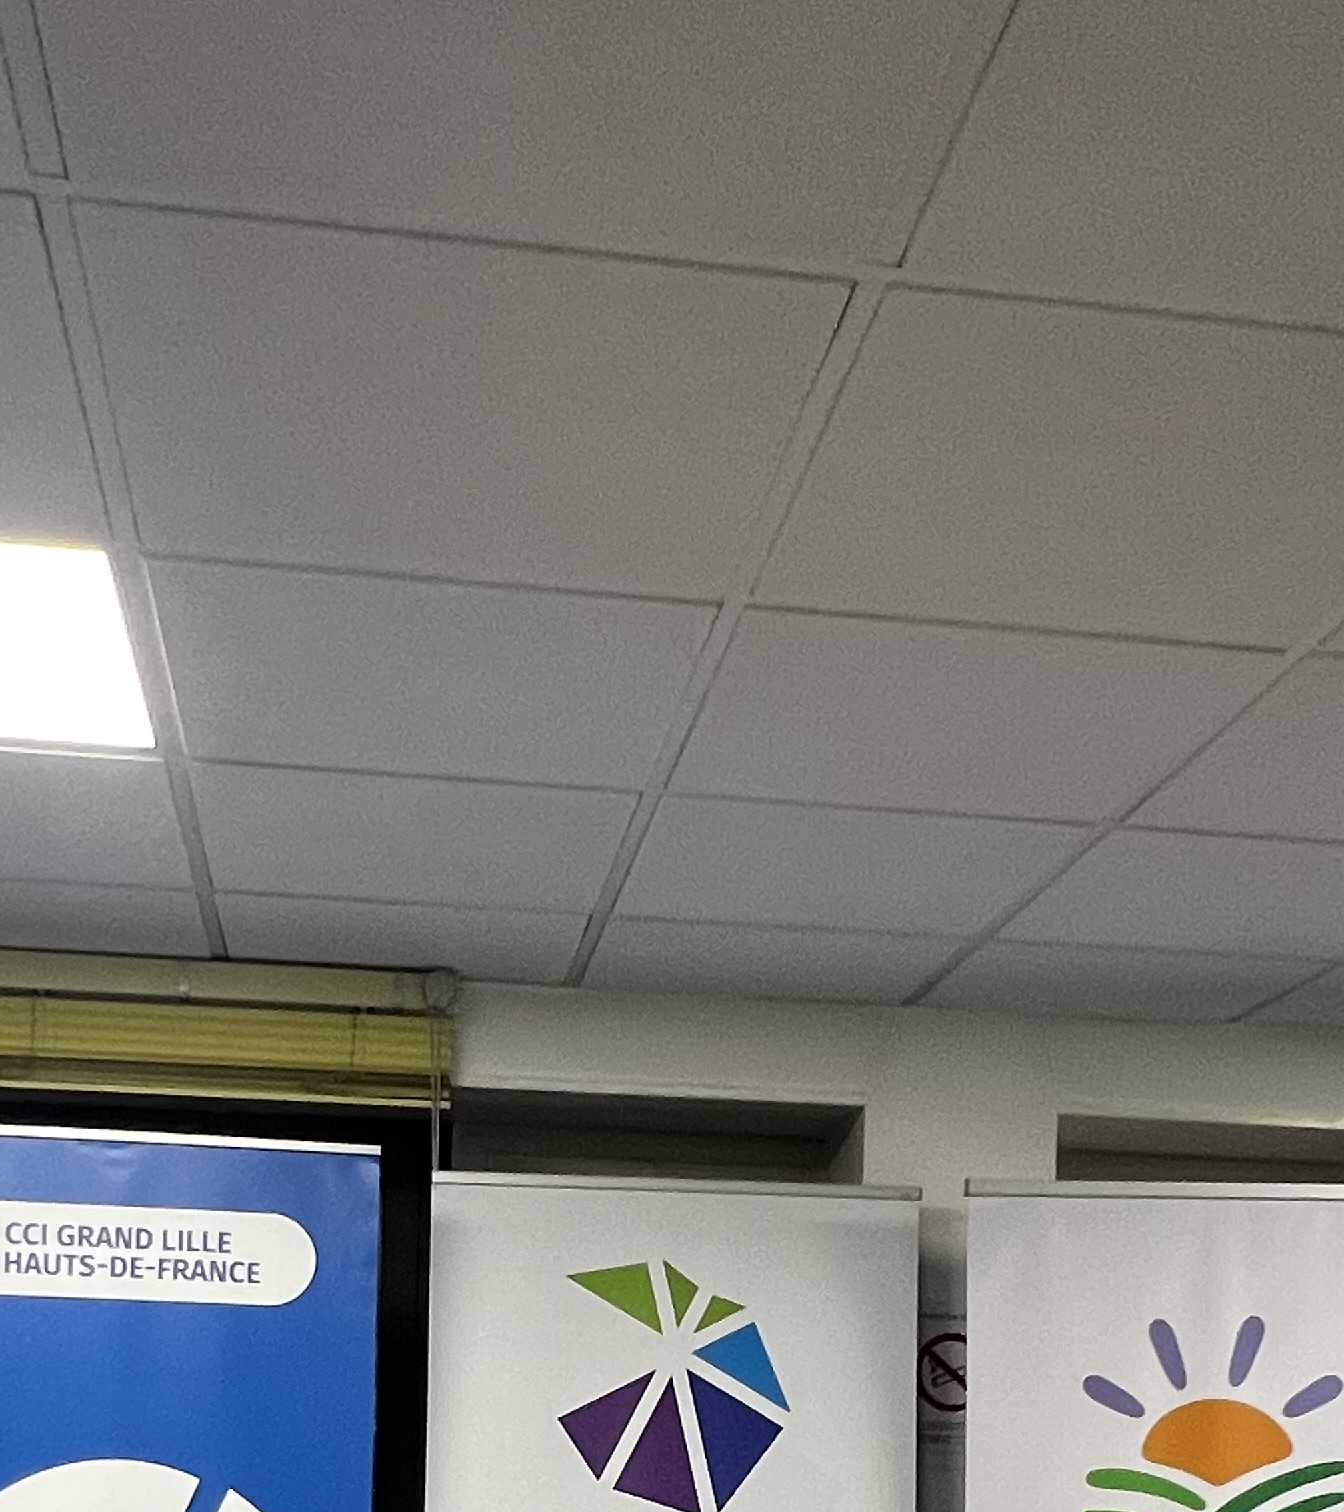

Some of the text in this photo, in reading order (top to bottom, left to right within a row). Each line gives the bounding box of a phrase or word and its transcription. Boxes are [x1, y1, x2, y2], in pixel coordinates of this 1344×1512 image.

[5, 1222, 232, 1254] CCI GRAND LILLE
[4, 1252, 261, 1284] HAUTS-DE-FRANCE
